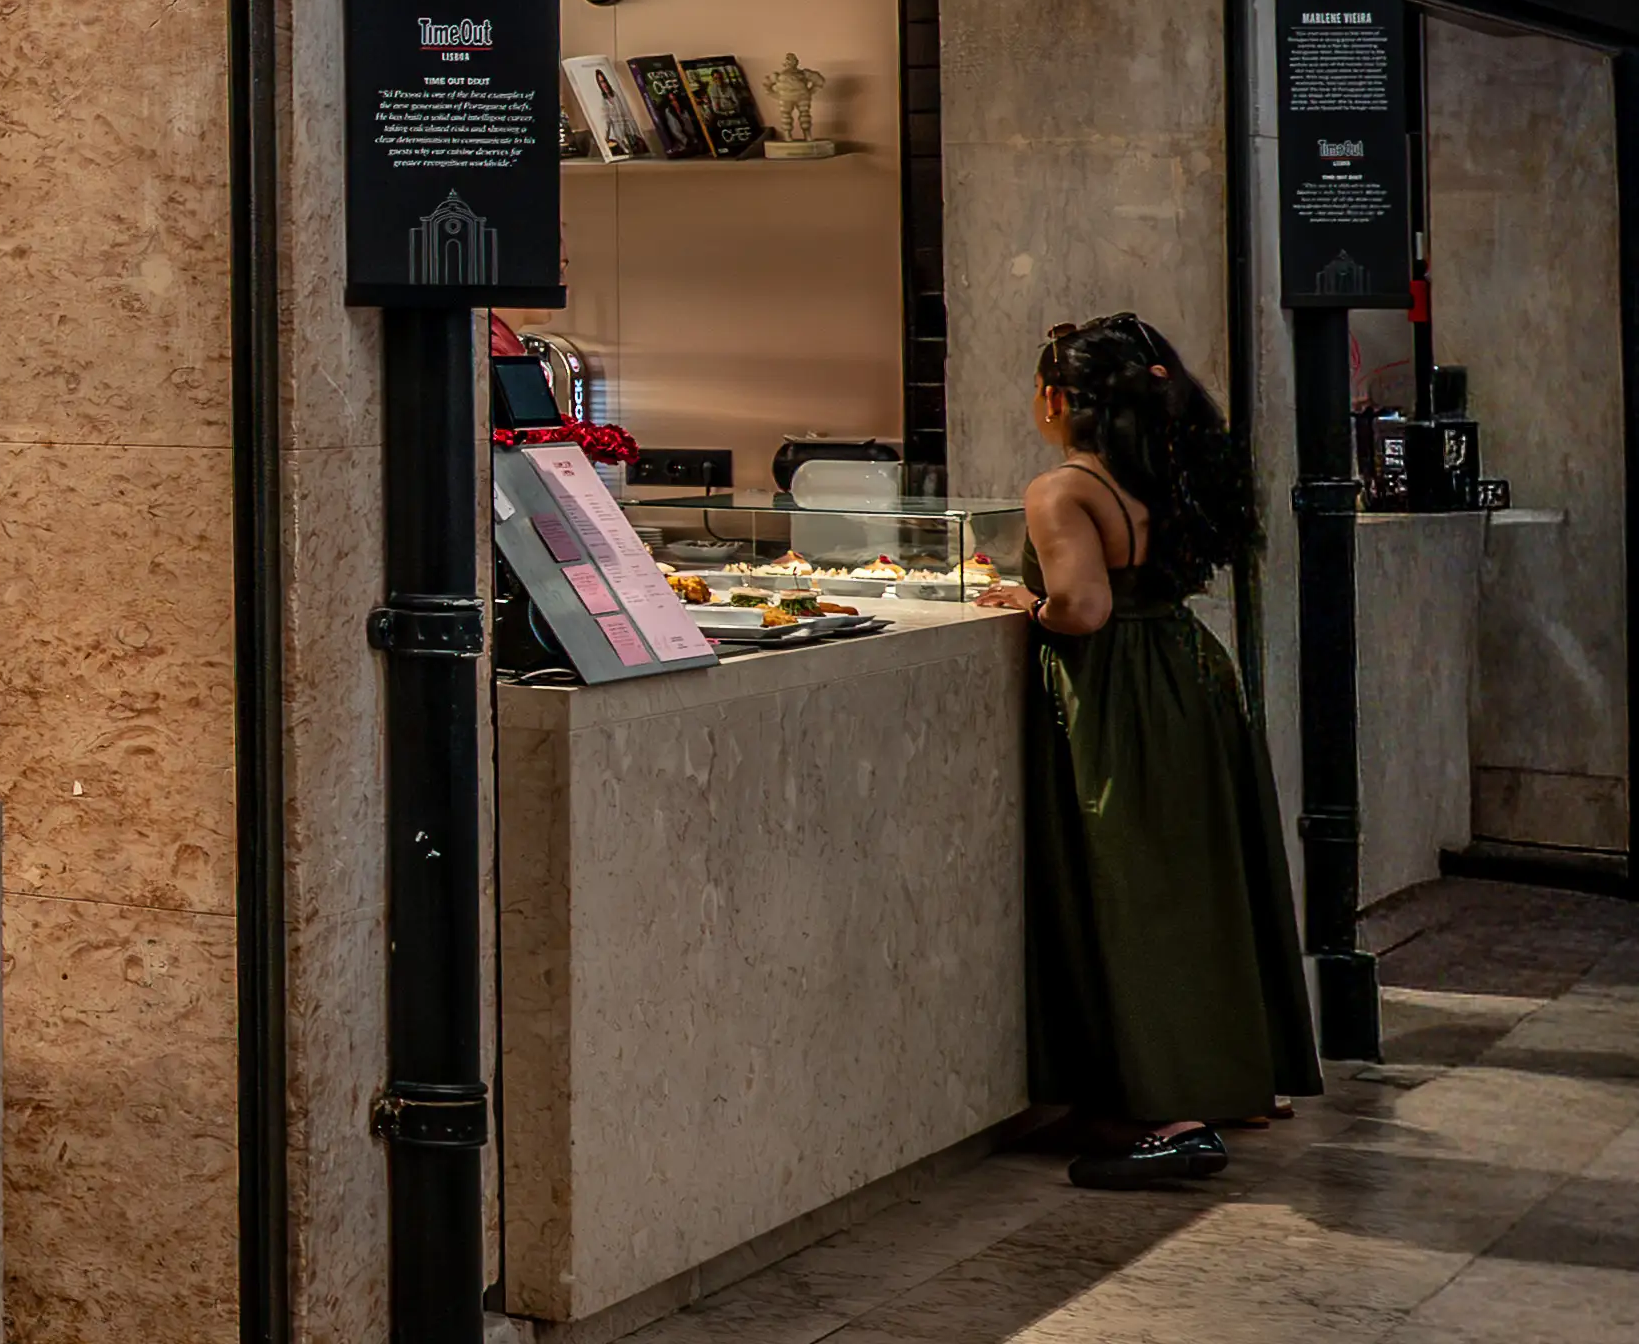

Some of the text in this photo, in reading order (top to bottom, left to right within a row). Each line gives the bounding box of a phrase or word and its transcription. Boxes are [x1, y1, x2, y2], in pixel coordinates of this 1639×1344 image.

[1302, 13, 1371, 24] MARLENE VIEIRA
[441, 52, 470, 61] LISBOA
[424, 77, 464, 85] TIME OUT
